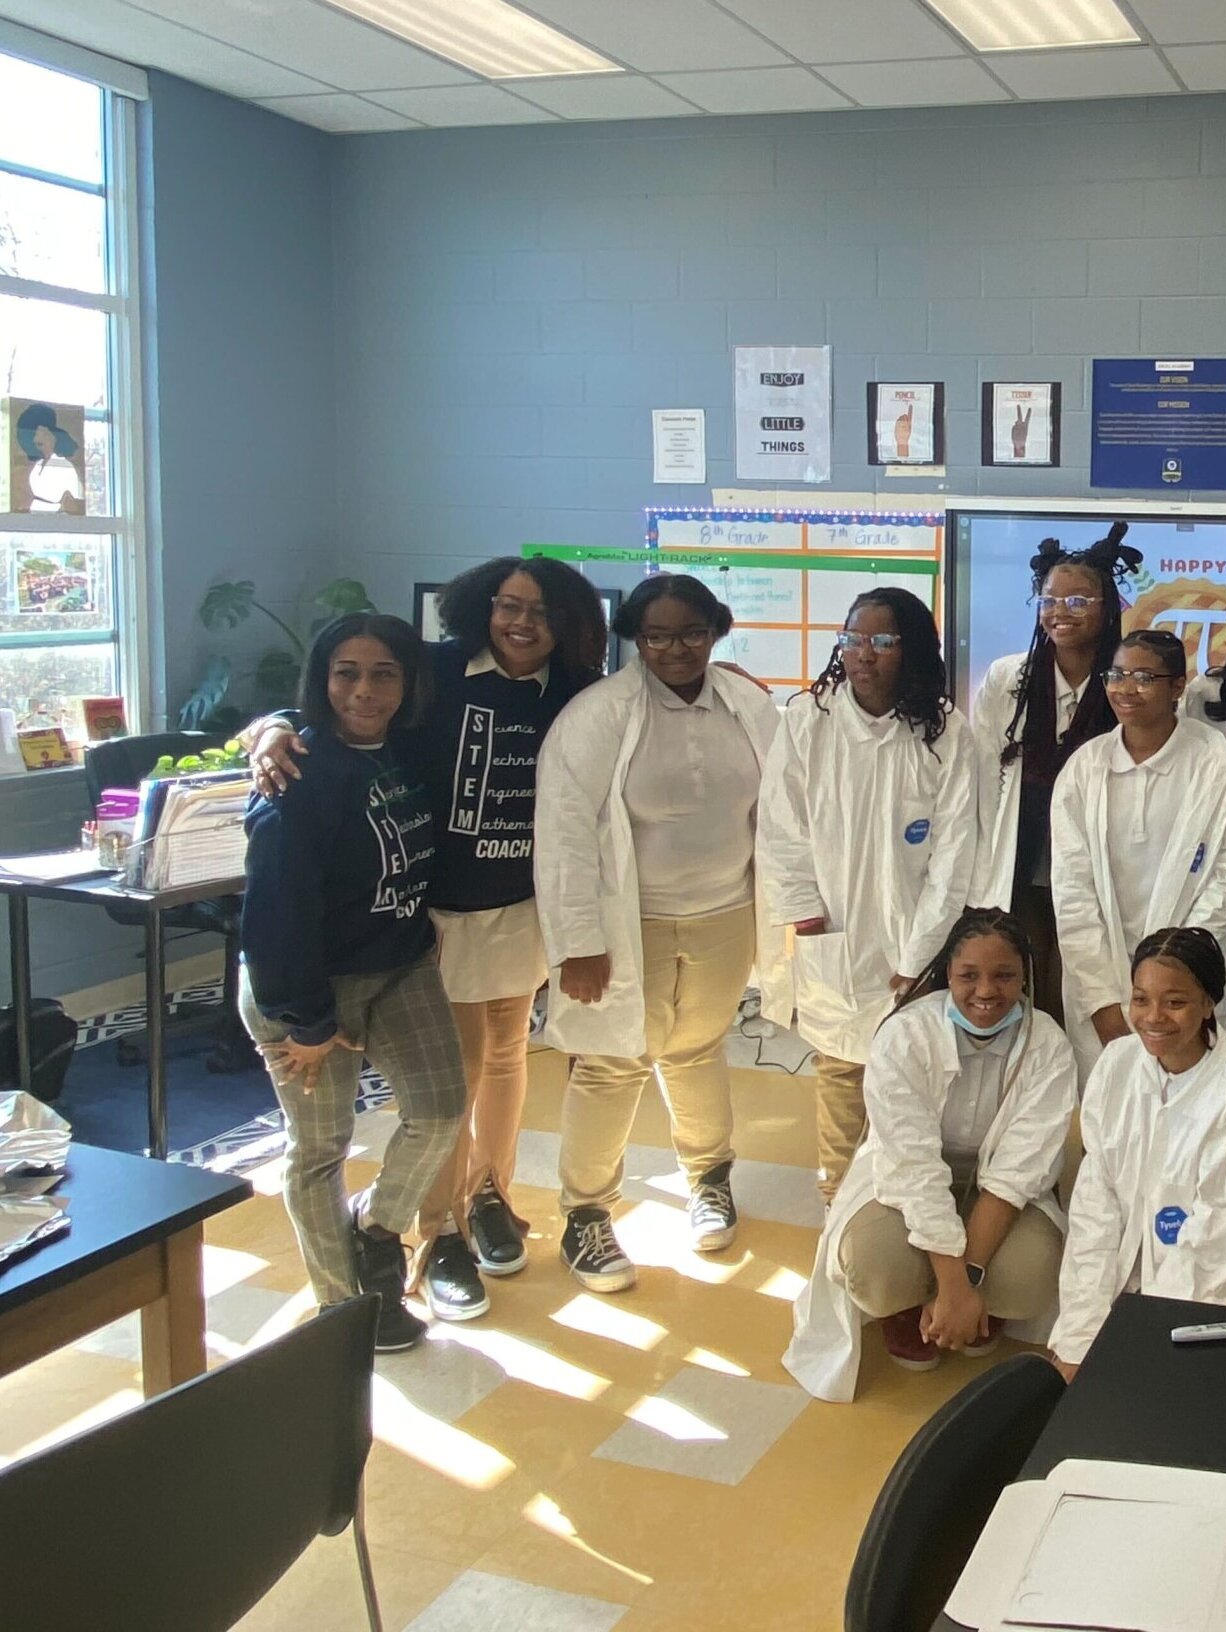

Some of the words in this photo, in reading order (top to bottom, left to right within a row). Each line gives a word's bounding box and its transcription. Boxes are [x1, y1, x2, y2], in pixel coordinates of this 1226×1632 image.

[763, 373, 801, 385] ENJOY
[764, 418, 801, 430] LITTLE
[760, 441, 805, 452] THINGS
[728, 525, 769, 545] Grade
[855, 528, 900, 546] Grade
[1160, 559, 1226, 573] HAPPY
[475, 838, 533, 859] COACH
